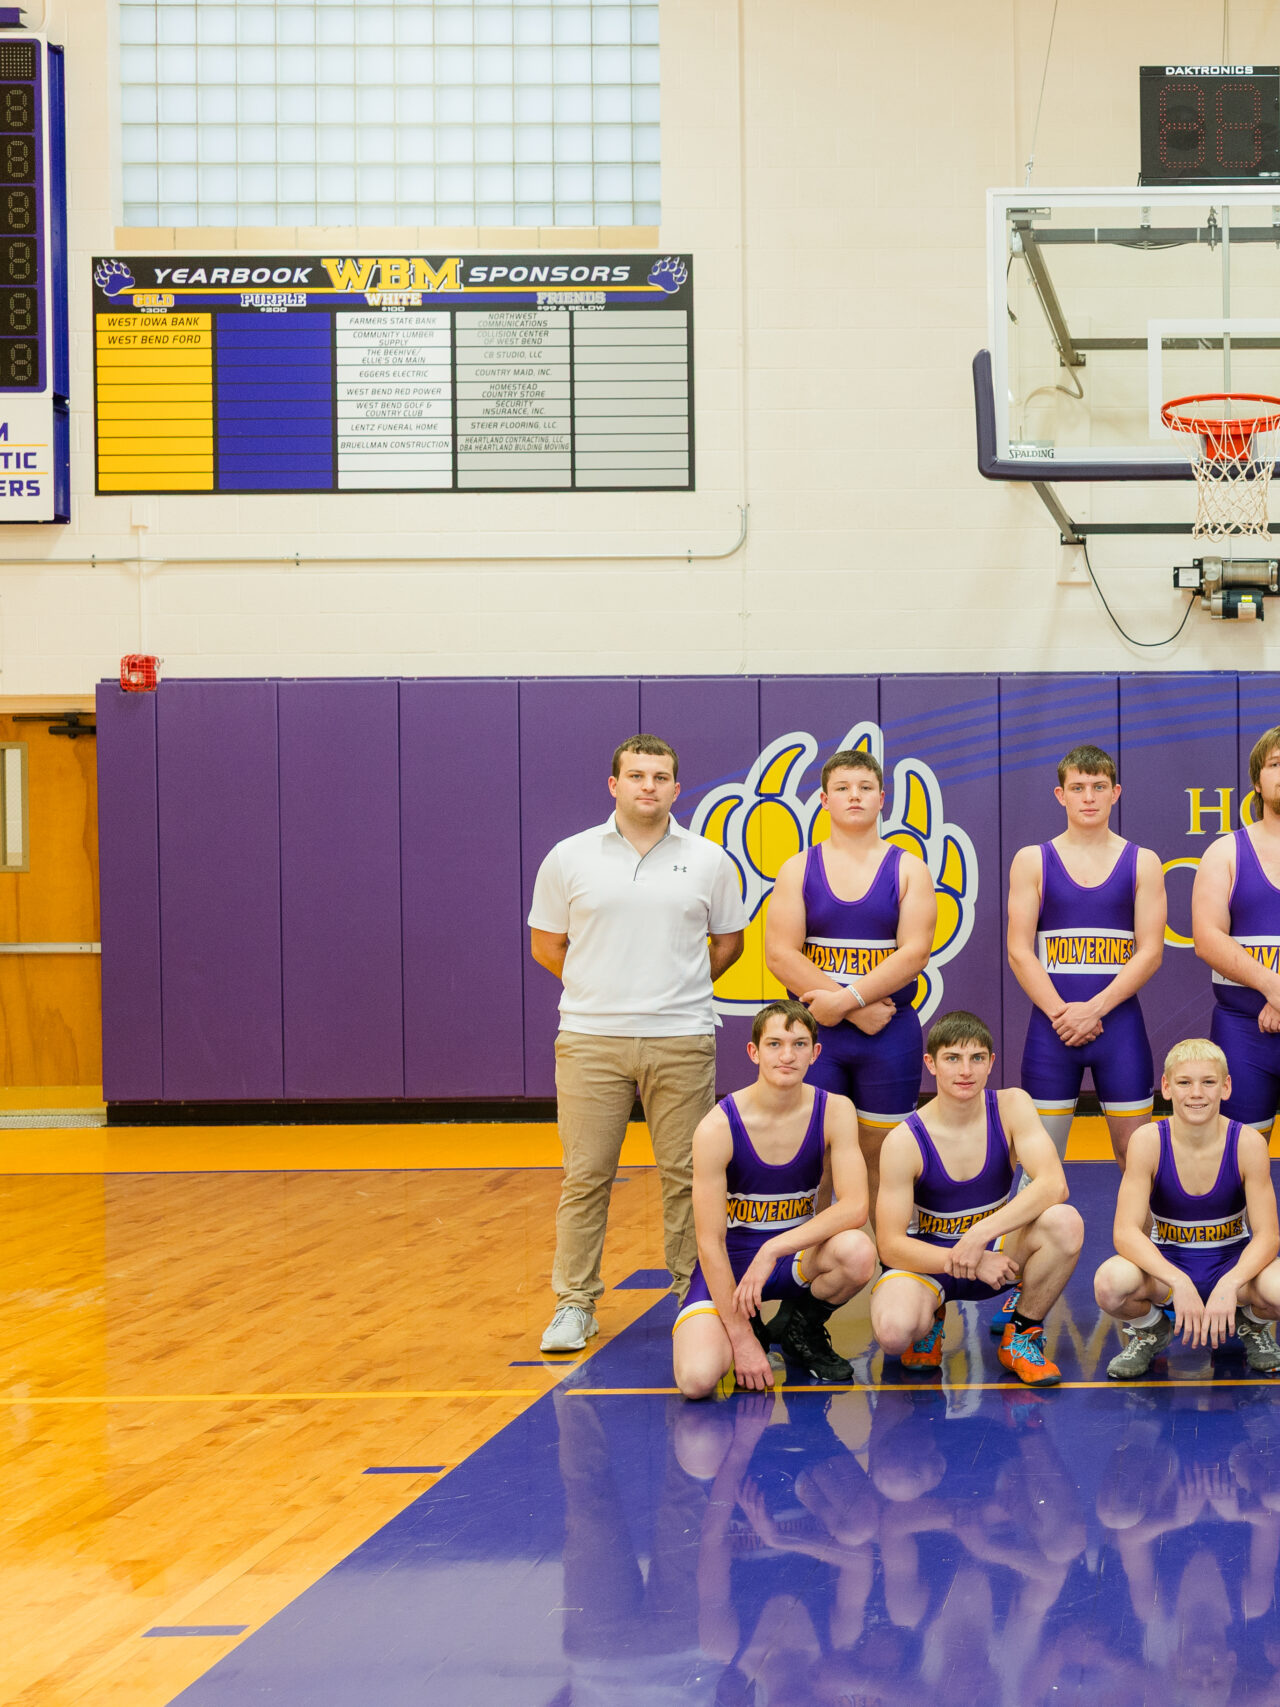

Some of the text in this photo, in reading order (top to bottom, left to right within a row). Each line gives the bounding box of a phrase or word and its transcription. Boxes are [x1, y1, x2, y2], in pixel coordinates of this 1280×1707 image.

[1165, 66, 1254, 75] DAKTRONICS
[154, 257, 631, 293] YEARBOOK WBM SPONSORS
[133, 294, 175, 307] GOLD
[240, 293, 307, 307] PURPLE
[364, 292, 423, 306] WHITE
[536, 291, 607, 305] FRIENDS
[349, 317, 437, 325] FARMERS STATE BANK
[488, 312, 537, 320] NORTHWEST
[107, 317, 200, 327] WEST IOWA BANK
[477, 330, 518, 338] COLLISION
[107, 335, 202, 345] WEST BEND FORD
[346, 388, 369, 396] WEST
[495, 400, 534, 408] SECURITY
[543, 421, 557, 429] LLC
[340, 441, 450, 449] BRUELLMAN CONSTRUCTION
[475, 443, 513, 451] HEARTLAND
[1009, 448, 1055, 459] SPALDING
[1045, 936, 1134, 969] WOLVERINES
[1155, 1215, 1243, 1243] WOLVERINES
